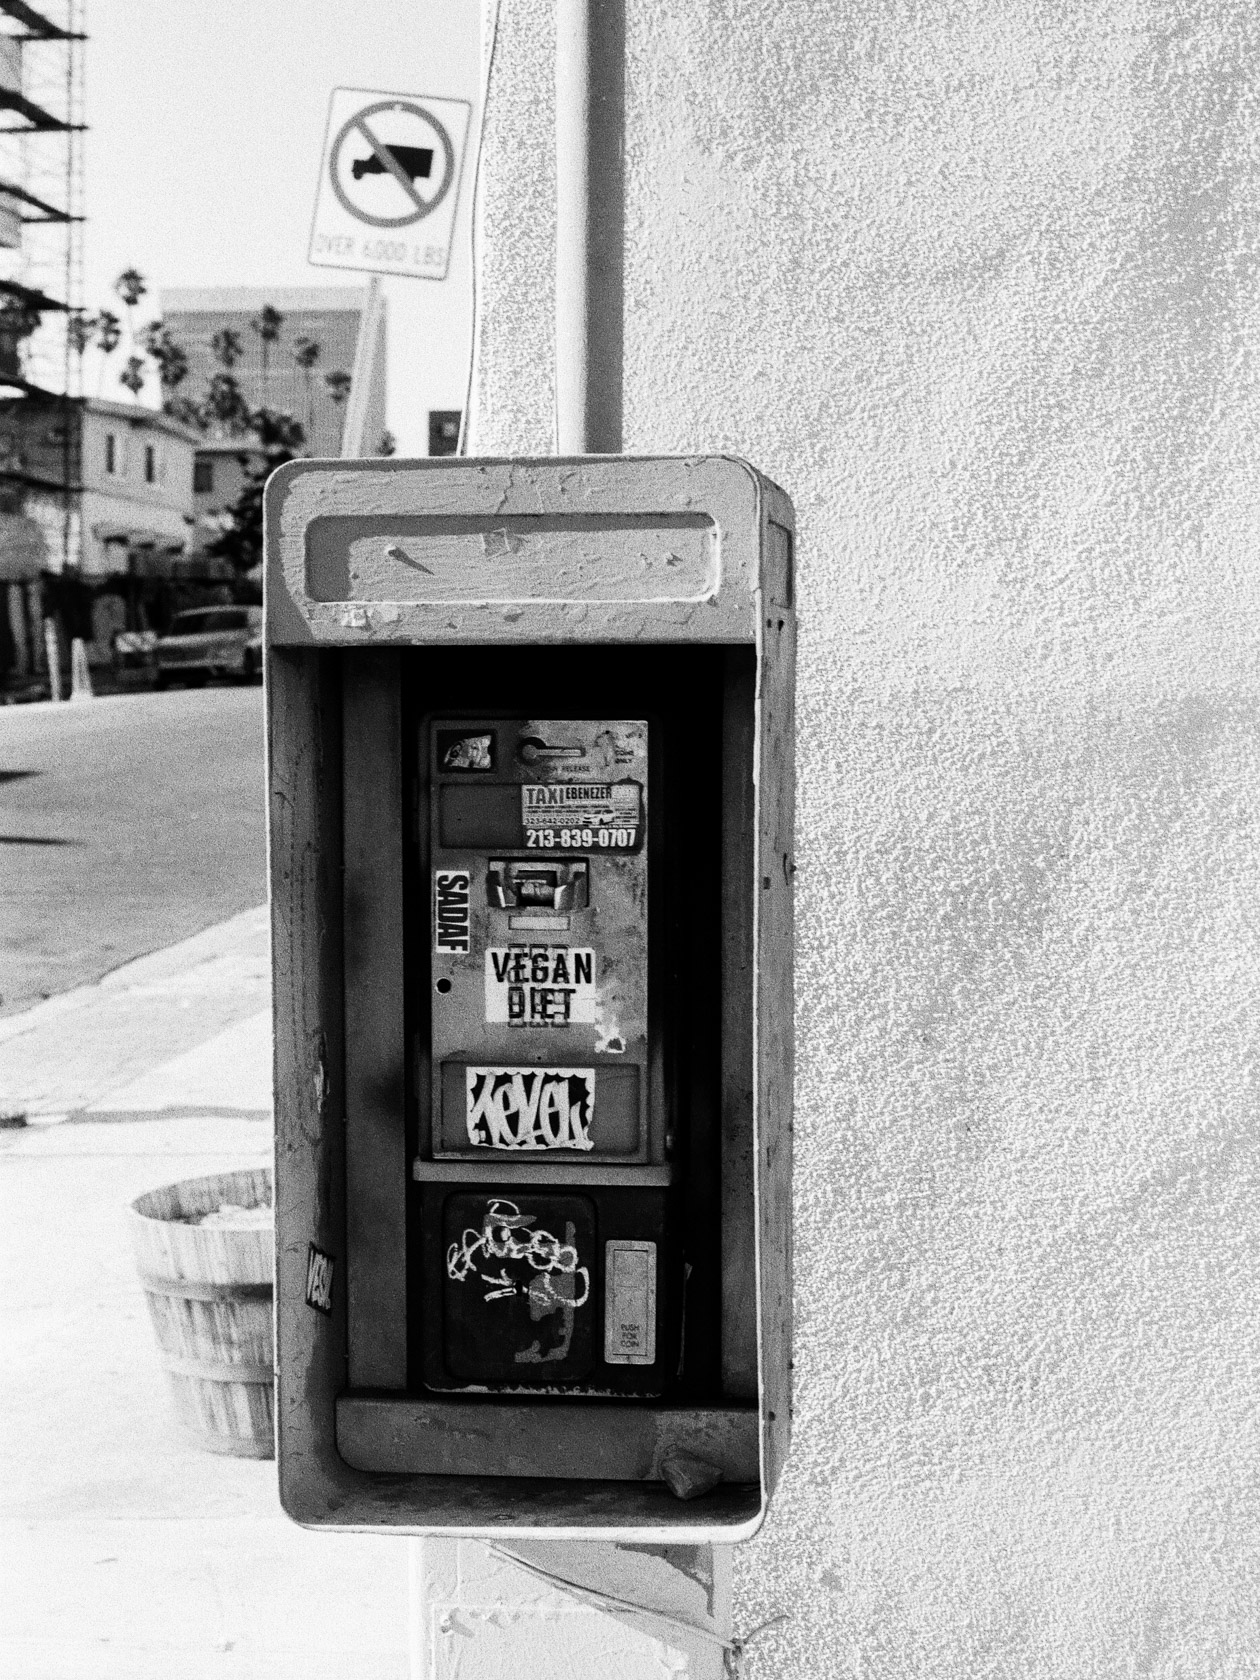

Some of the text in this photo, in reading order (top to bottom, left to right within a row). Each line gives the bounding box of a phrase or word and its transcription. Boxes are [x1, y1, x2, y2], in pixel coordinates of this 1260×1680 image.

[315, 233, 354, 256] OVER
[413, 244, 445, 267] LBS
[526, 786, 612, 805] TAXI EBENEZER
[526, 828, 636, 847] 213-839-0707
[438, 874, 469, 952] SADAF
[491, 952, 592, 984] VEGAN
[509, 986, 576, 1019] DIET
[621, 1323, 639, 1331] PUSH
